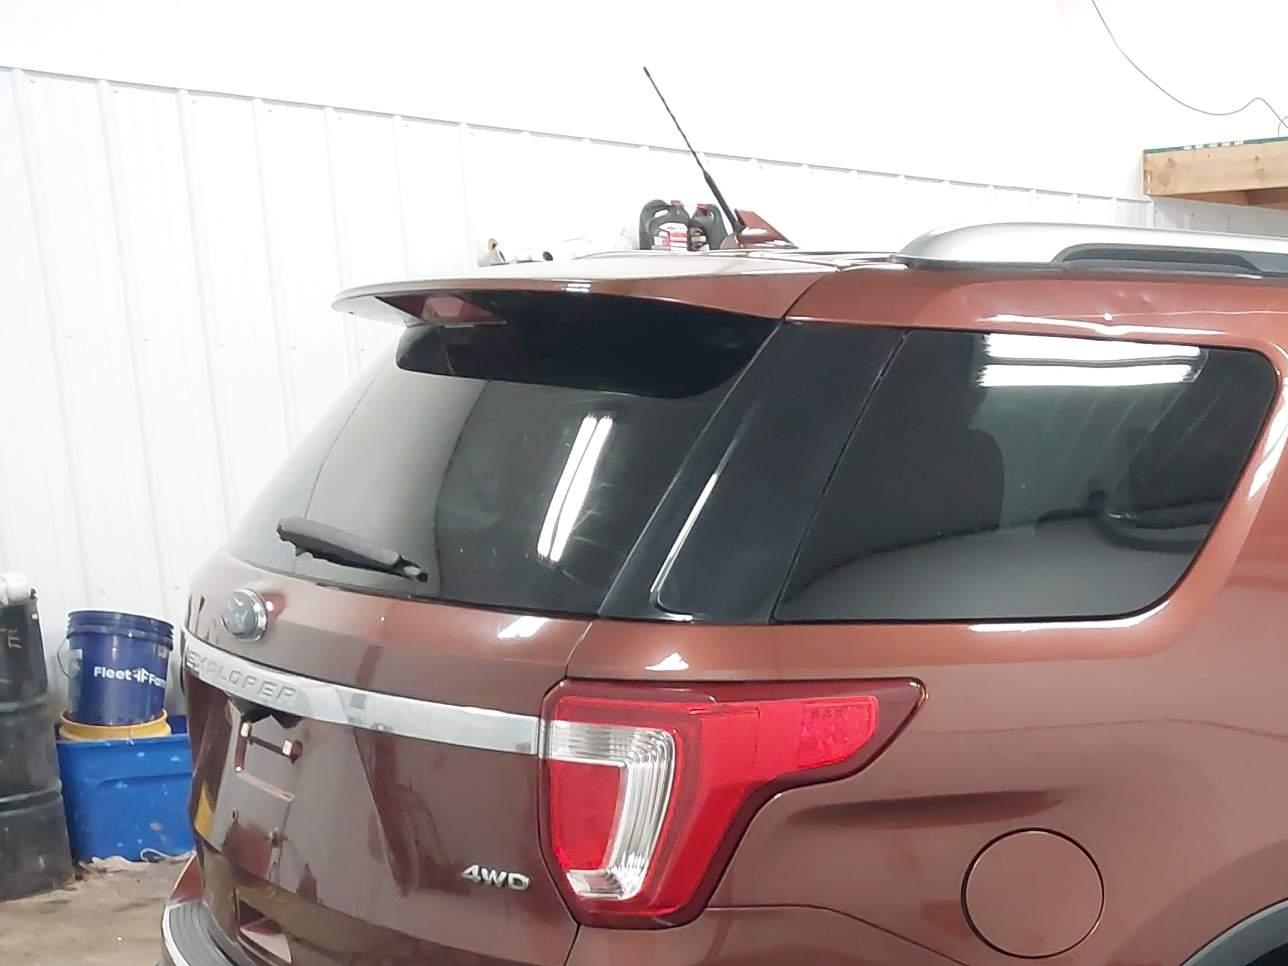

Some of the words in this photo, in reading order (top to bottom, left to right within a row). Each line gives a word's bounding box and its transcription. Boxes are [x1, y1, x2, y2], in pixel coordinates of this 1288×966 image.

[93, 665, 132, 681] Fleet
[185, 649, 297, 701] EXPLORER
[461, 864, 531, 892] 4WD
